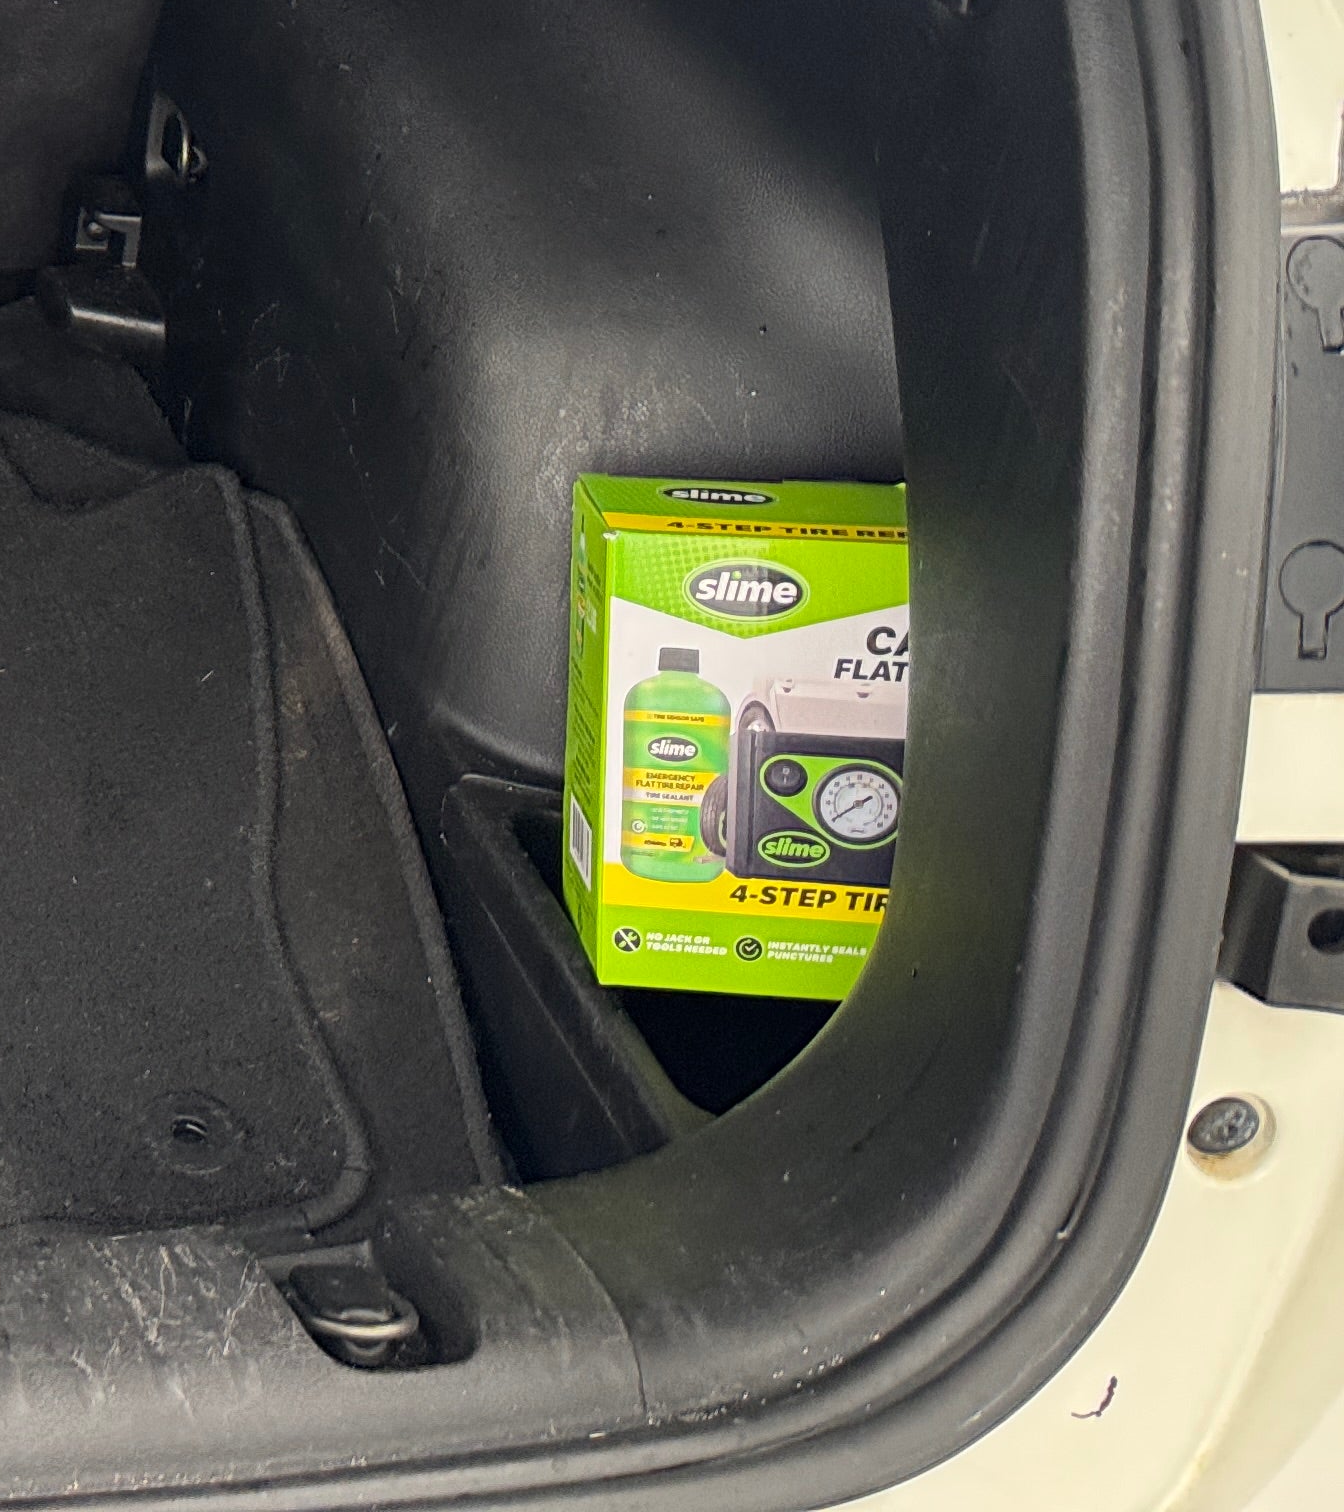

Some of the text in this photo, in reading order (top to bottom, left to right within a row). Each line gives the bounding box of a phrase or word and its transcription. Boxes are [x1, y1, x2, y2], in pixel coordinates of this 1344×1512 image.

[672, 489, 766, 503] slime
[666, 521, 772, 532] 4-STEP
[778, 526, 849, 537] TIRE
[695, 570, 798, 604] slime
[833, 658, 909, 682] FLAT
[650, 739, 696, 756] slime
[646, 772, 696, 782] EMERGENCY
[635, 779, 705, 791] FLAT TIRE REPAIR
[764, 837, 825, 858] slime
[729, 884, 837, 909] 4-STEP
[646, 932, 711, 945] NO JACK OR
[646, 941, 728, 956] TOOLS NEEDED
[767, 941, 831, 954] INSTANTLY
[767, 950, 834, 963] PUNCTURES
